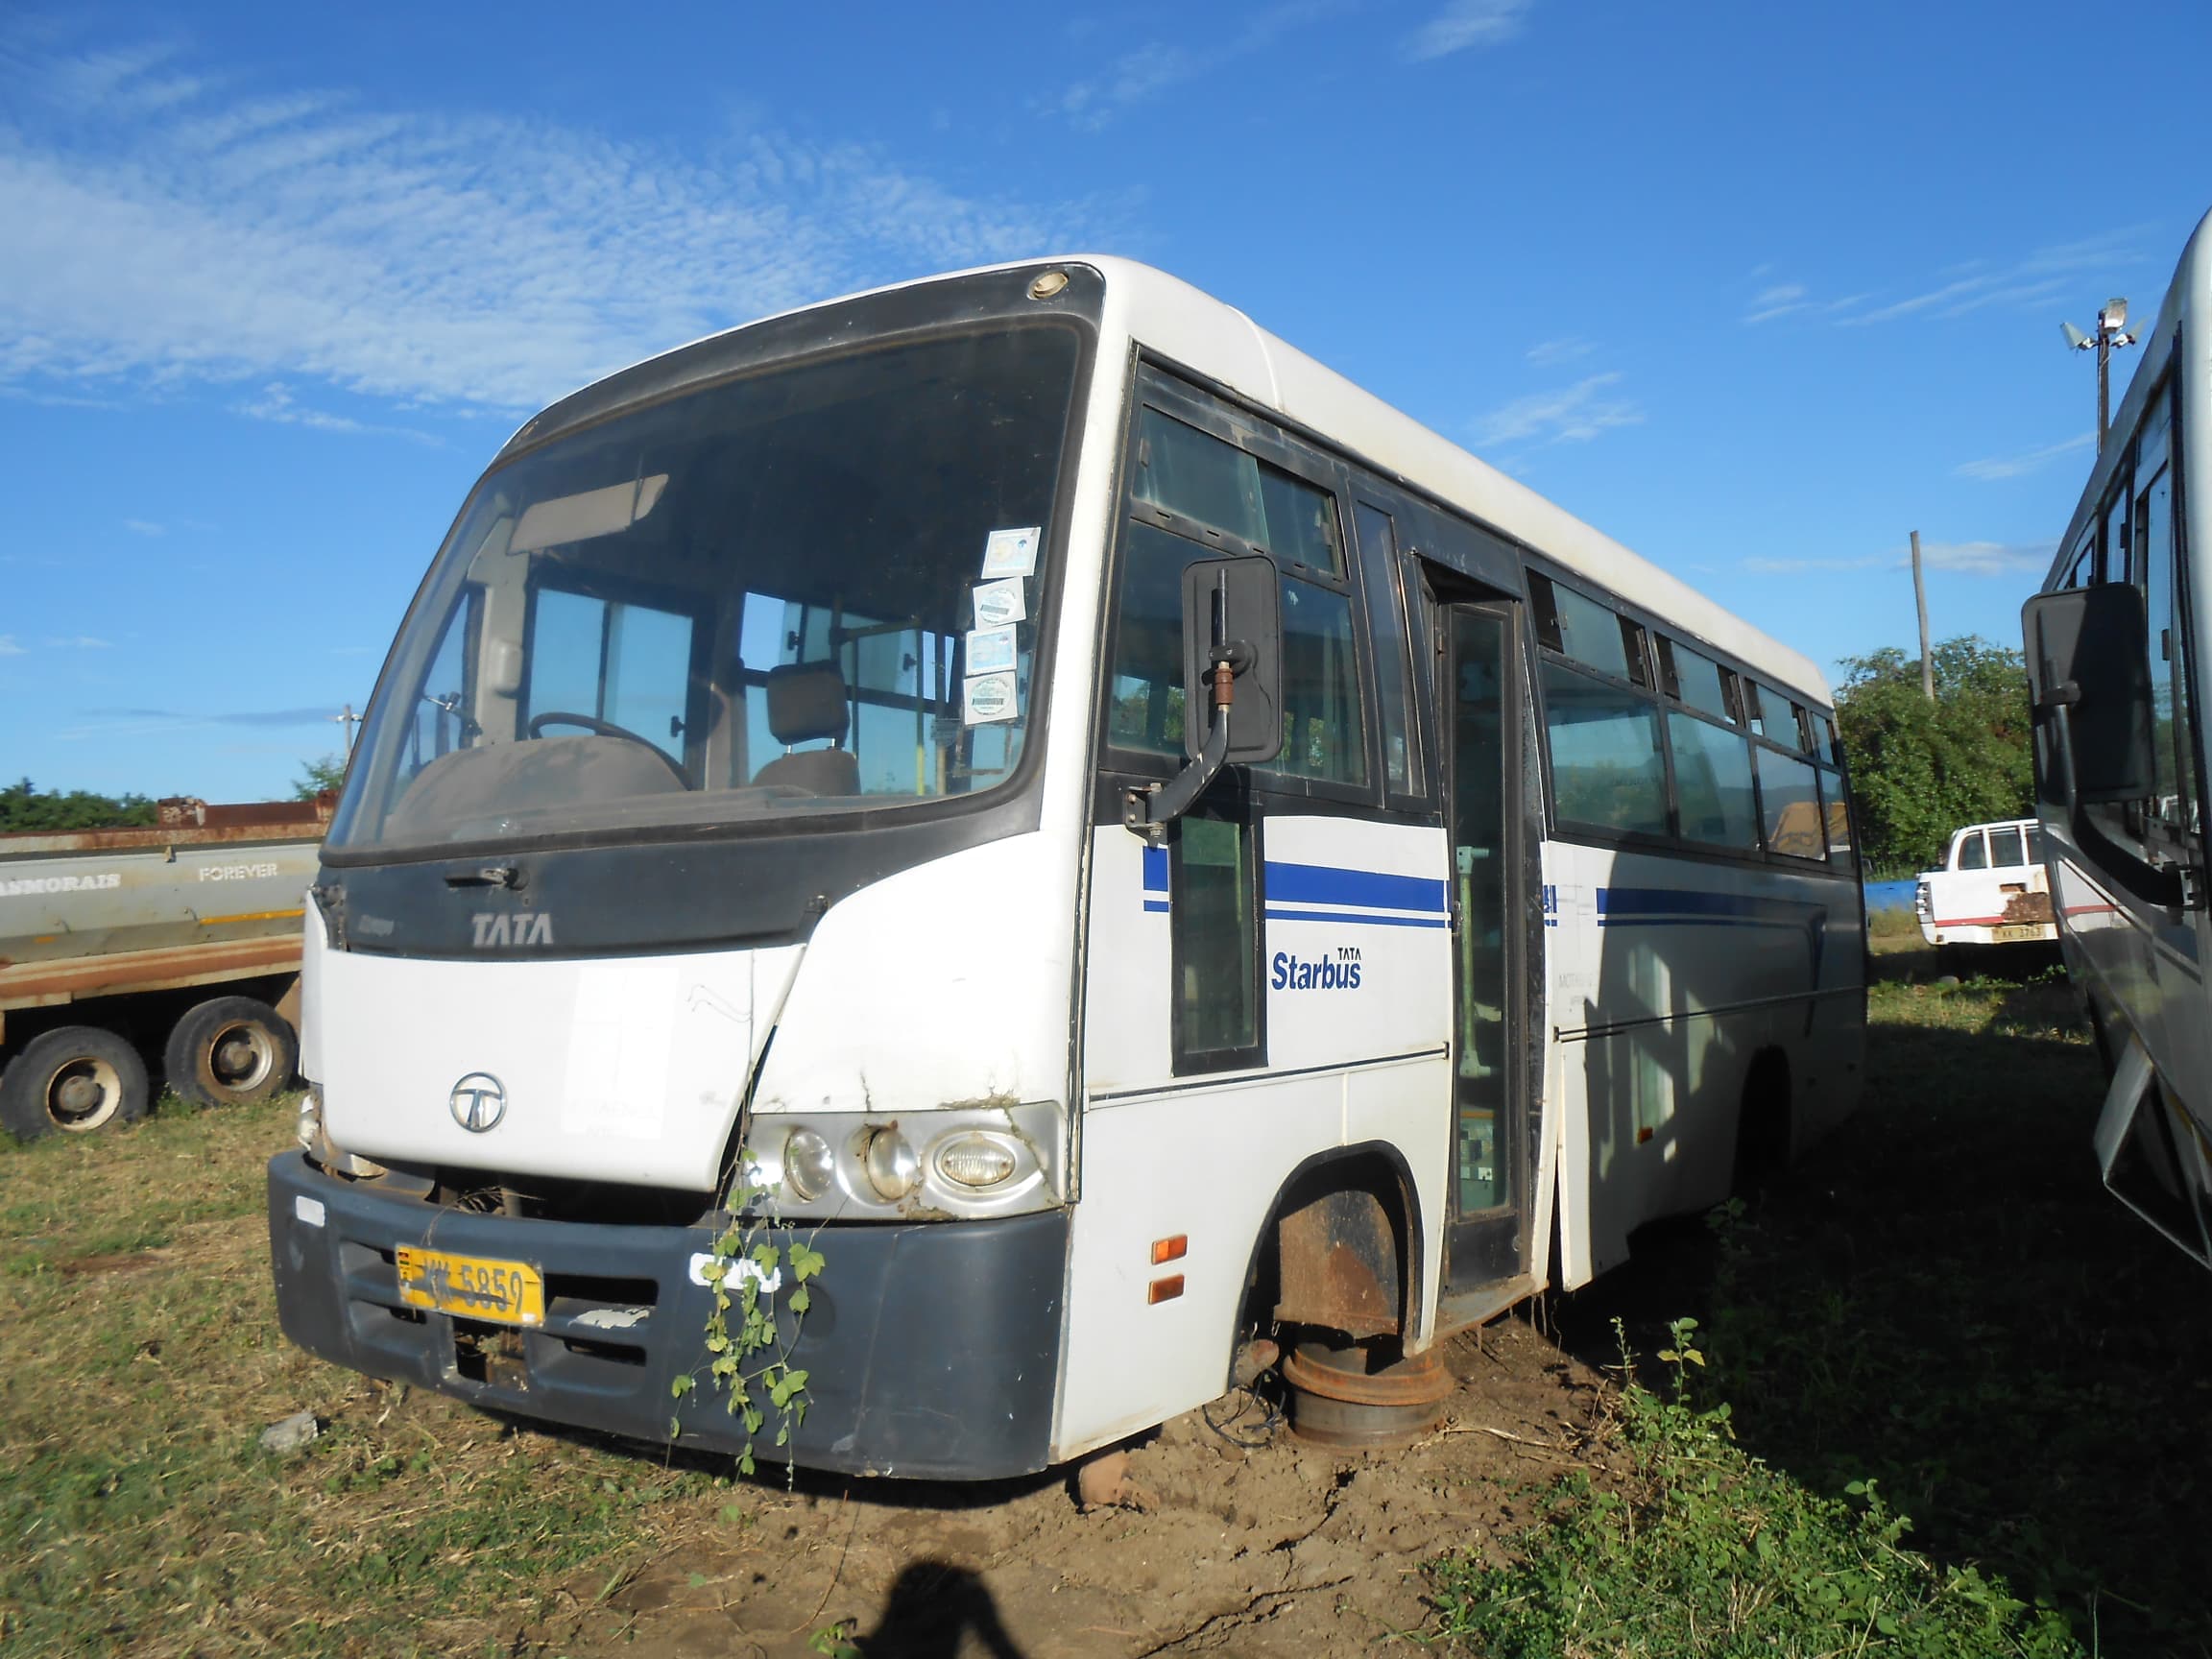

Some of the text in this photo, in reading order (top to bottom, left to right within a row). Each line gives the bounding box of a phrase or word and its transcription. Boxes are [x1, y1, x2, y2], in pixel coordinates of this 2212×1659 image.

[199, 863, 277, 882] FOREVER
[472, 913, 554, 947] TATA
[1271, 951, 1361, 990] Starbus
[1337, 948, 1361, 960] TATA
[461, 1264, 523, 1313] 5859
